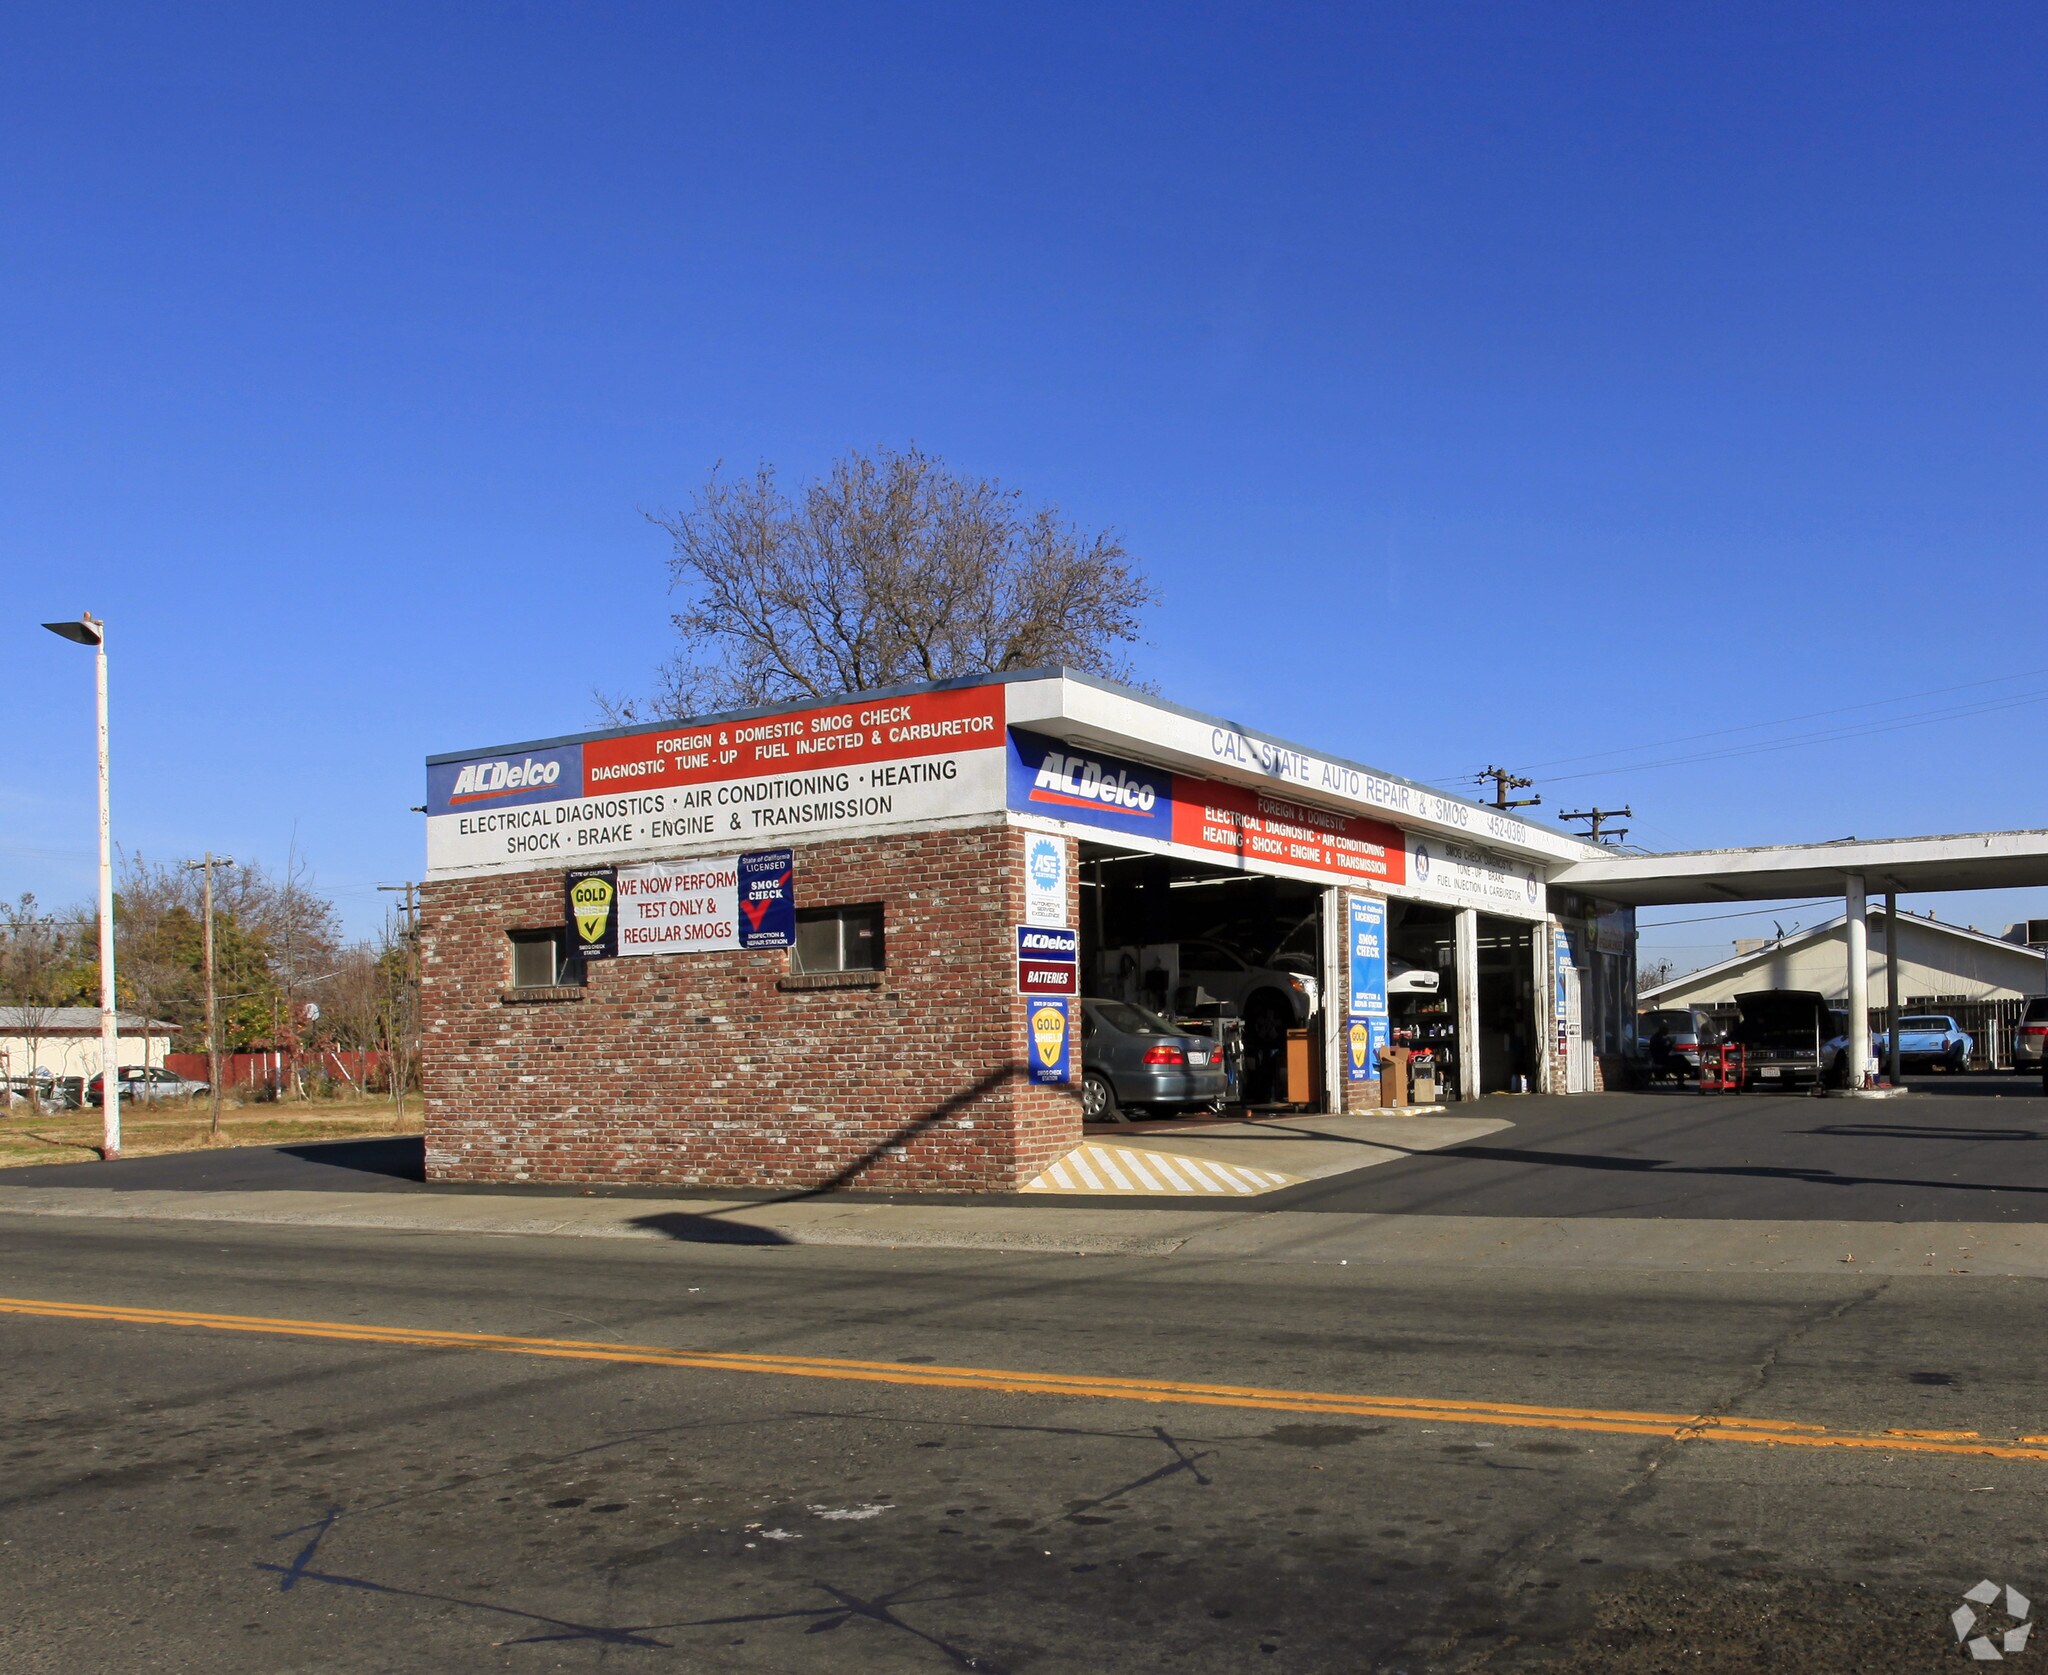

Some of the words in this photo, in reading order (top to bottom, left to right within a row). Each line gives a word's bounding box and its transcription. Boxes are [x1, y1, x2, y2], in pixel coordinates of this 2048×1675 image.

[656, 734, 712, 755] FOREIGN
[718, 732, 729, 746] &
[735, 721, 804, 744] DOMESTIC
[811, 714, 853, 733] SMOG
[860, 706, 911, 727] CHECK
[591, 759, 665, 781] DIAGNOSTIC
[755, 743, 790, 761] FUEL
[796, 733, 864, 755] INJECTED
[871, 731, 882, 745] &
[889, 716, 995, 743] CARBURETOR
[453, 758, 560, 795] ACDelco
[1034, 751, 1156, 811] ACDelco
[1211, 728, 1247, 763] CAL
[1262, 744, 1310, 782] STATE
[1321, 764, 1360, 795] AUTO
[1366, 776, 1410, 810] REPAIR
[1418, 794, 1427, 815] &
[1436, 798, 1469, 827] SMOG
[1488, 817, 1526, 844] 452-0369
[460, 808, 551, 835] ELECTRICAL
[556, 795, 665, 825] DIAGNOSTICS
[684, 790, 712, 809] AIR
[717, 772, 849, 806] CONDITIONING
[871, 760, 957, 788] HEATING
[507, 832, 561, 854] SHOCK
[577, 823, 633, 846] BRAKE
[651, 814, 714, 838] ENGINE
[729, 812, 742, 830] &
[752, 795, 893, 828] TRANSMISSION
[1258, 799, 1295, 819] FOREIGN
[1298, 808, 1305, 822] &
[1308, 810, 1346, 832] DOMESTIC
[1205, 805, 1262, 832] ELECTRICAL
[1265, 820, 1315, 842] DIAGNOSTIC
[1322, 834, 1336, 848] AIR
[1336, 837, 1386, 857] CONDITIONING
[764, 853, 791, 862] California
[1203, 825, 1244, 847] HEATING
[1252, 835, 1283, 855] SHOCK
[1290, 843, 1321, 863] ENGINE
[1325, 850, 1332, 865] &
[1336, 853, 1387, 875] TRANSMISSION
[1446, 845, 1462, 859] SMOG
[1464, 849, 1482, 863] CHECK
[746, 861, 785, 872] LICENSED
[1034, 854, 1057, 874] ASE
[618, 879, 637, 896] WE
[640, 876, 673, 894] NOW
[675, 871, 737, 892] PERFORM
[751, 880, 780, 891] SMOG
[1488, 870, 1505, 883] BRAKE
[576, 887, 607, 902] GOLD
[749, 889, 783, 900] CHECK
[1437, 874, 1451, 888] FUEL
[1454, 878, 1481, 893] INJECTION
[1483, 884, 1488, 895] &
[1489, 885, 1522, 901] CARBURETOR
[637, 901, 667, 918] TEST
[669, 898, 704, 917] ONLY
[707, 897, 718, 914] &
[1355, 911, 1380, 924] LICENSED
[624, 925, 682, 944] REGULAR
[685, 921, 732, 941] SMOGS
[1022, 933, 1075, 951] ACDelco
[1358, 933, 1378, 946] SMOG
[1356, 945, 1380, 958] CHECK
[1027, 971, 1069, 985] BATTERIES
[1037, 1018, 1060, 1030] GOLD
